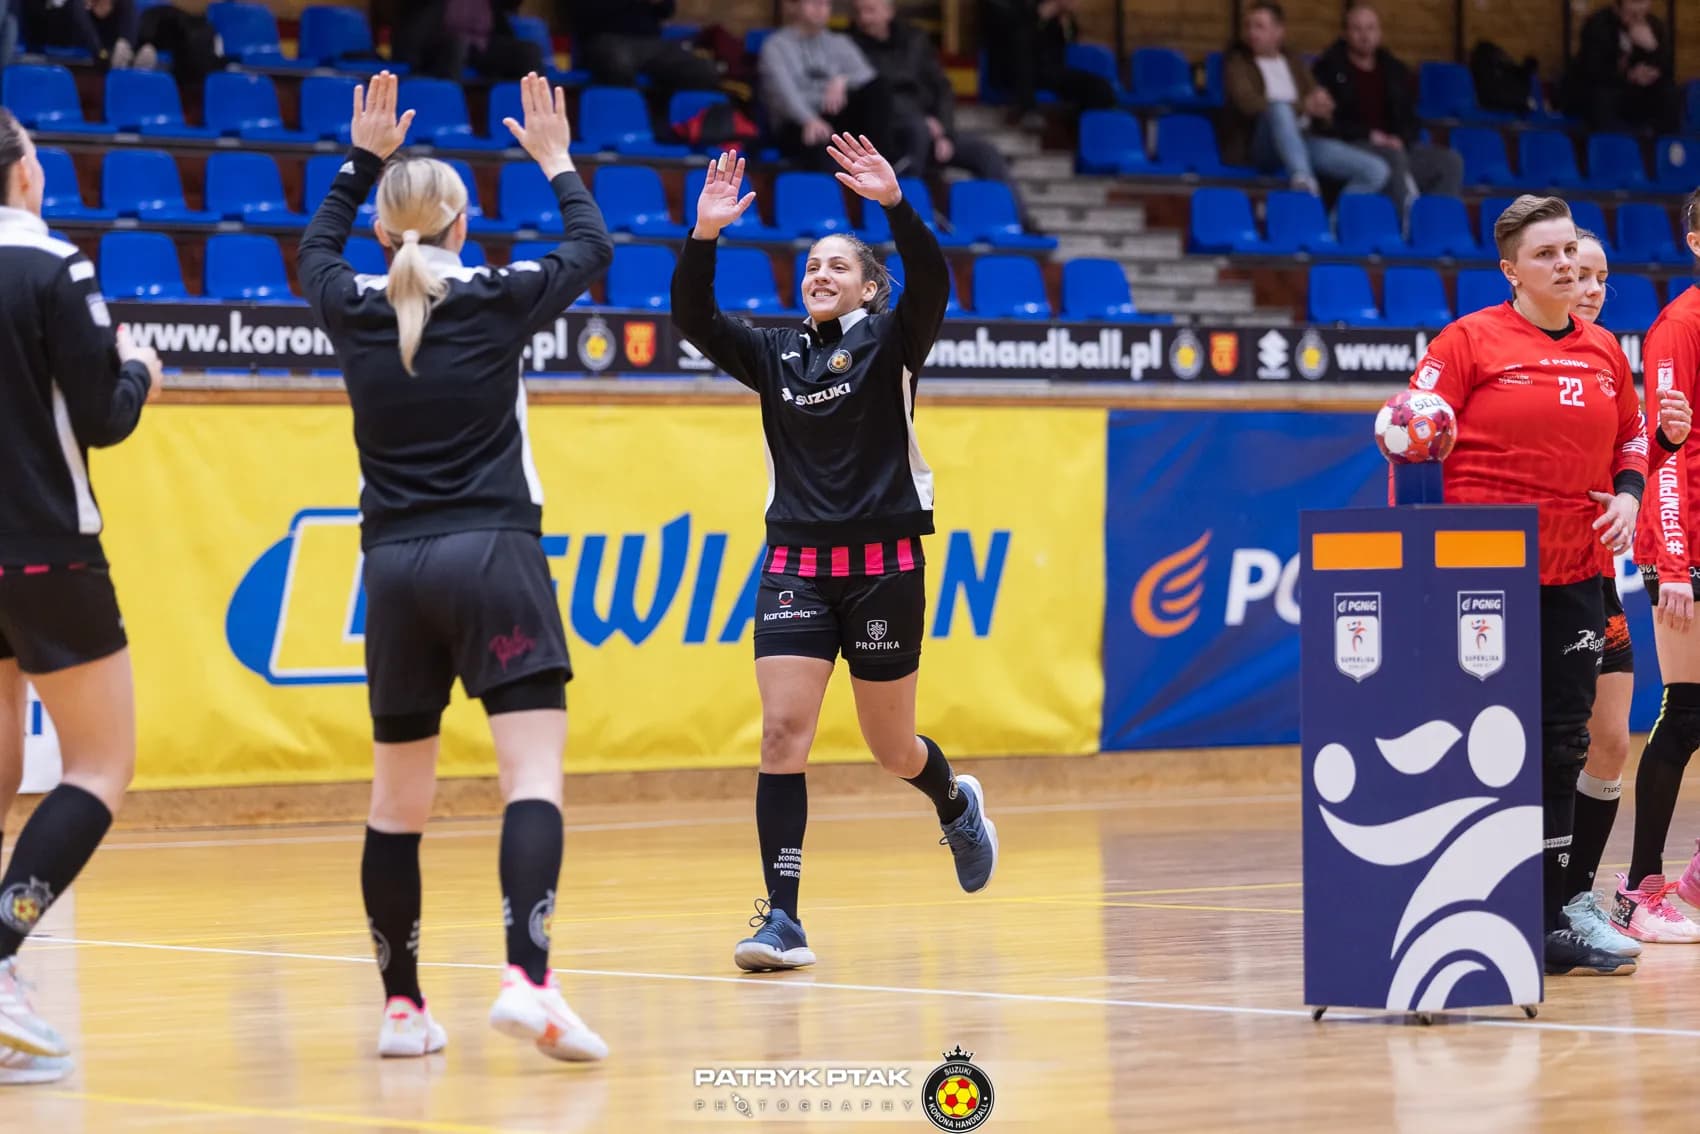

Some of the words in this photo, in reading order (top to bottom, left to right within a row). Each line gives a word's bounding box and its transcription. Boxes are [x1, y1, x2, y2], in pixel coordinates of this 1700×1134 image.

[795, 382, 851, 406] SUZUKI
[1557, 376, 1585, 408] 22
[855, 640, 901, 650] PROFIKA
